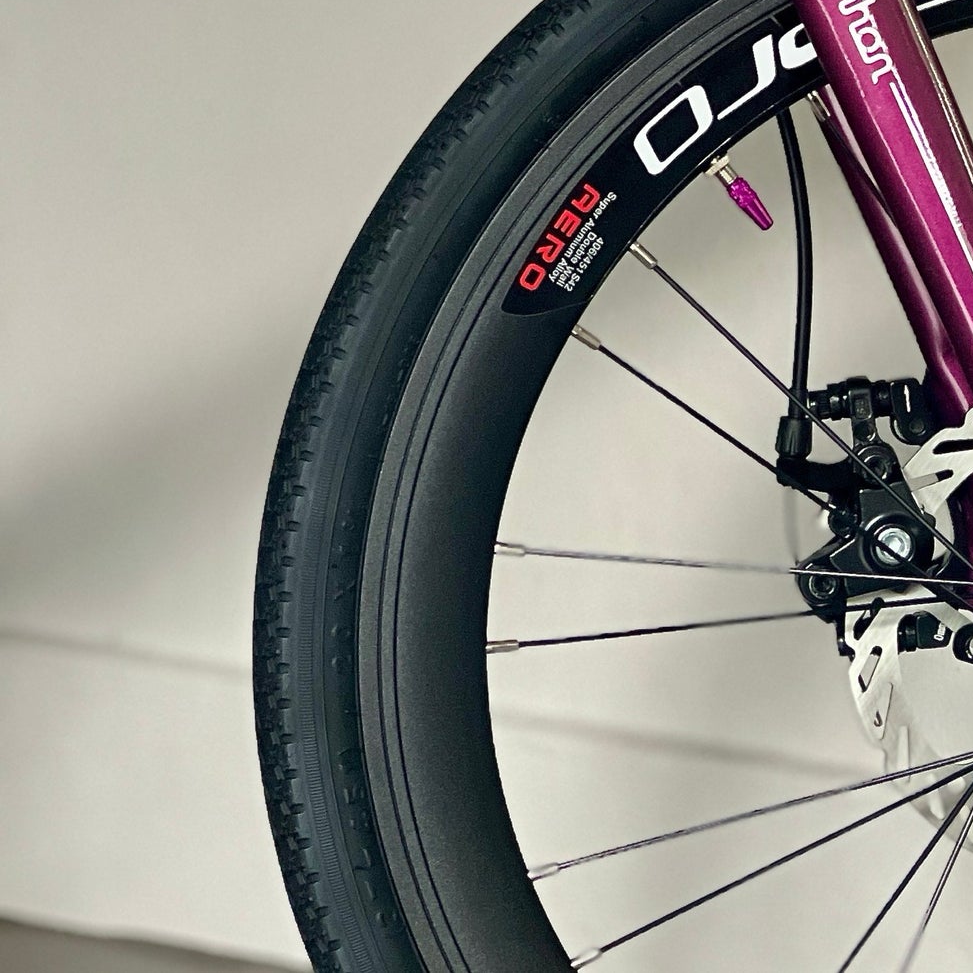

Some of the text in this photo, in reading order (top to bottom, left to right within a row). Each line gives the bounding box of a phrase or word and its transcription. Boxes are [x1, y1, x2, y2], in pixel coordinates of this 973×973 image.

[592, 191, 618, 220] Super
[519, 183, 600, 291] AERO
[555, 231, 598, 287] Double Wall
[563, 236, 605, 292] 406/451 S42
[548, 257, 568, 283] Alloy
